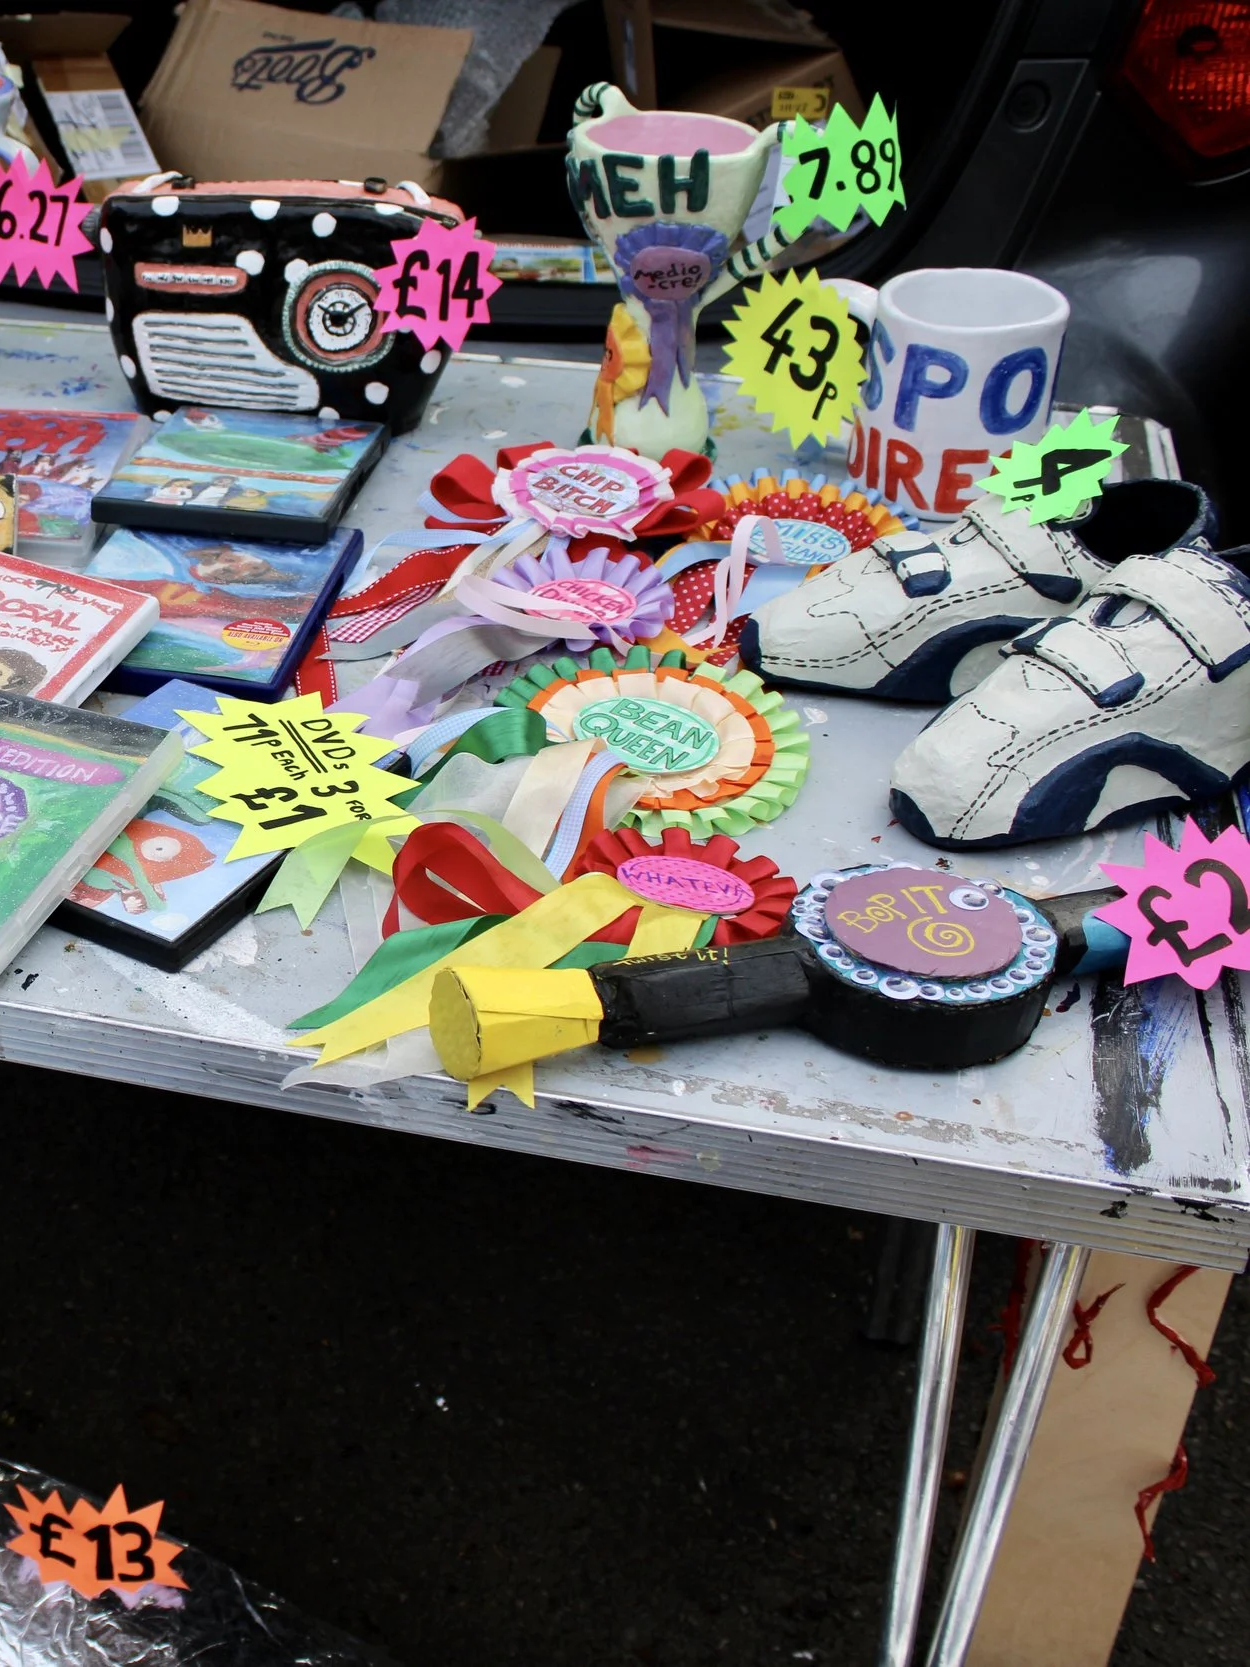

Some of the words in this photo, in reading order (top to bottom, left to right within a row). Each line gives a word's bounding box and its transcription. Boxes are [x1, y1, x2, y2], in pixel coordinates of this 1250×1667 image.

[231, 39, 376, 104] Boots
[566, 148, 710, 220] MEH
[799, 138, 896, 200] 7.89
[393, 250, 484, 321] £14
[862, 318, 1066, 435] SPO
[558, 465, 626, 493] CHIP
[846, 416, 1013, 514] DIRE
[532, 476, 618, 513] BITCH
[774, 520, 841, 550] MISS
[557, 581, 628, 614] CHICKEN
[579, 713, 690, 771] QUEEN
[609, 699, 714, 750] BEAN
[229, 786, 328, 830] £1
[310, 780, 360, 797] 3
[346, 800, 372, 821] FOR
[1137, 858, 1250, 967] £2
[29, 1513, 155, 1583] £13
